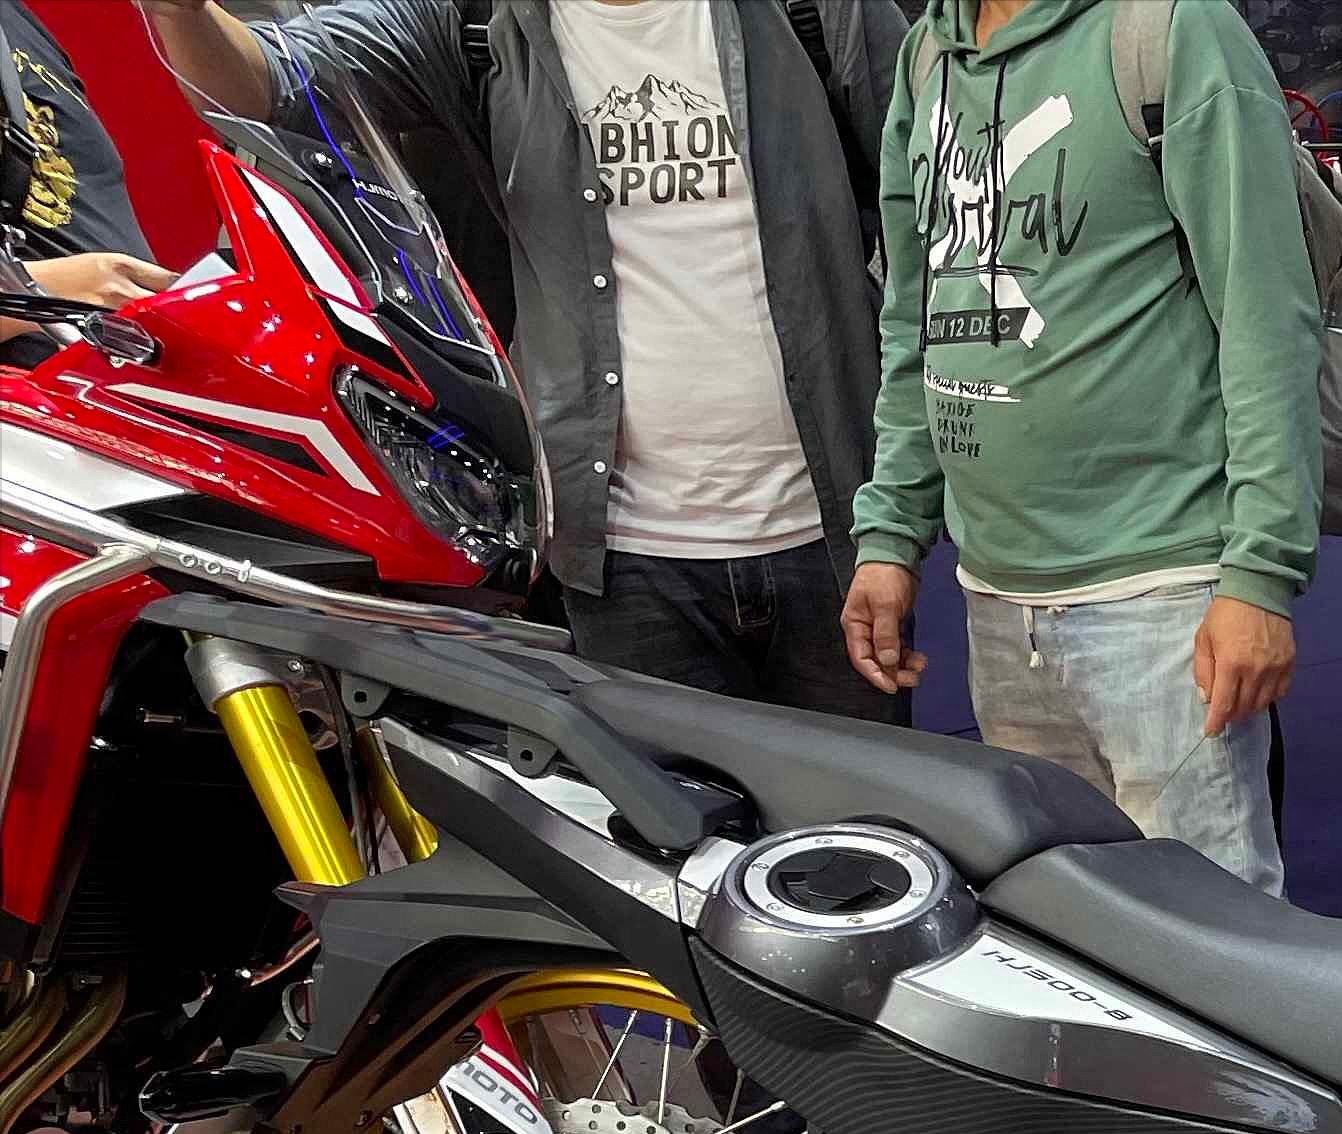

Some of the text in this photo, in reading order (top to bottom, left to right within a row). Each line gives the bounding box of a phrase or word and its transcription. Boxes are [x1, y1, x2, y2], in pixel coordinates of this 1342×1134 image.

[596, 157, 737, 207] SPORT
[949, 317, 965, 338] 12
[969, 314, 1012, 337] DEC
[981, 950, 1134, 1021] HJ500-B
